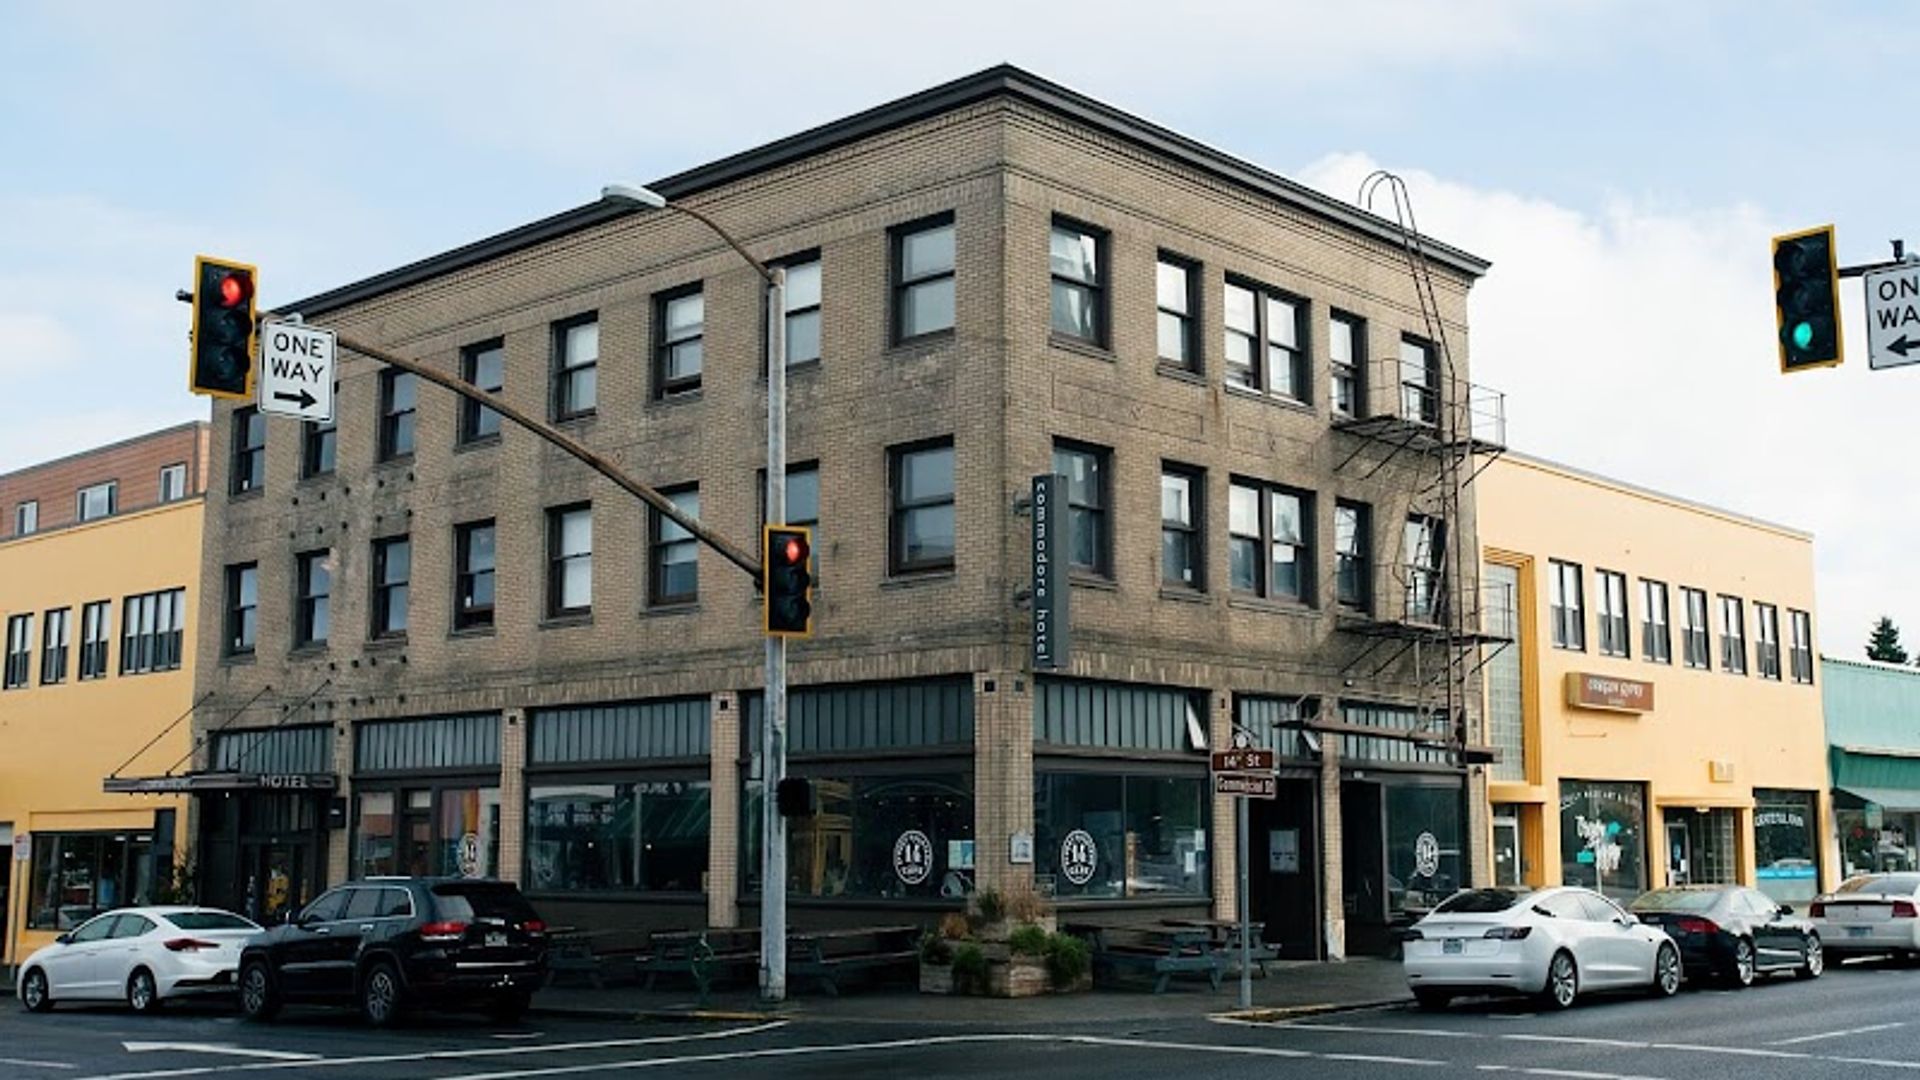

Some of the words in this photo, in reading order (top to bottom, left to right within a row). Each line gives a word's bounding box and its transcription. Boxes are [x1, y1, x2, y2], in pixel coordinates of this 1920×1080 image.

[1878, 276, 1920, 301] ON
[1877, 305, 1920, 329] WA
[273, 333, 324, 358] ONE
[271, 358, 324, 383] WAY
[1036, 482, 1048, 597] commodore
[1036, 609, 1049, 660] hotel
[1247, 754, 1260, 767] St
[260, 775, 309, 789] HOTEL
